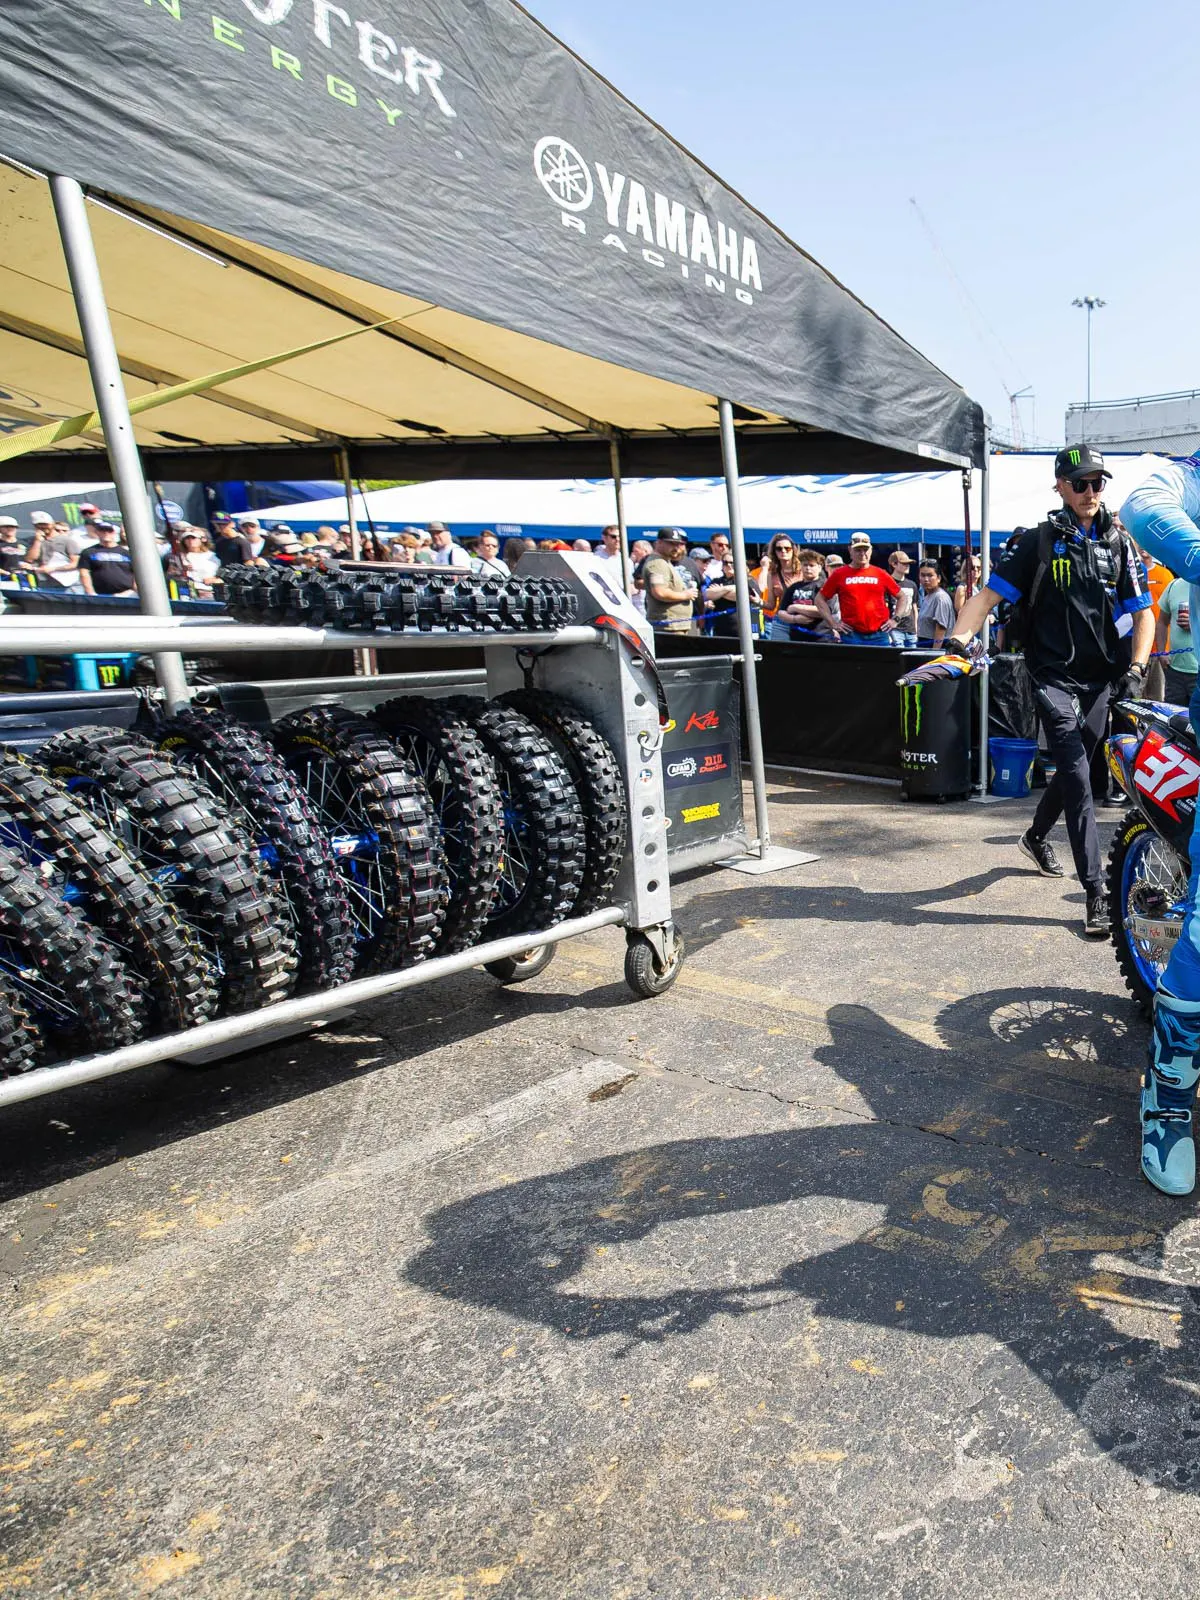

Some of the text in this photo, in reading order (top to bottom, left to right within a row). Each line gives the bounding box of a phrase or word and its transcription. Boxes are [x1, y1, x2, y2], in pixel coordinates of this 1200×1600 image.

[595, 162, 762, 291] YAMAHA
[561, 212, 753, 305] RACING
[812, 530, 839, 540] YAMAHA
[845, 576, 878, 585] DUCATI
[671, 762, 691, 773] AFAM
[1134, 745, 1200, 802] 37
[1124, 823, 1147, 845] DUNLOP
